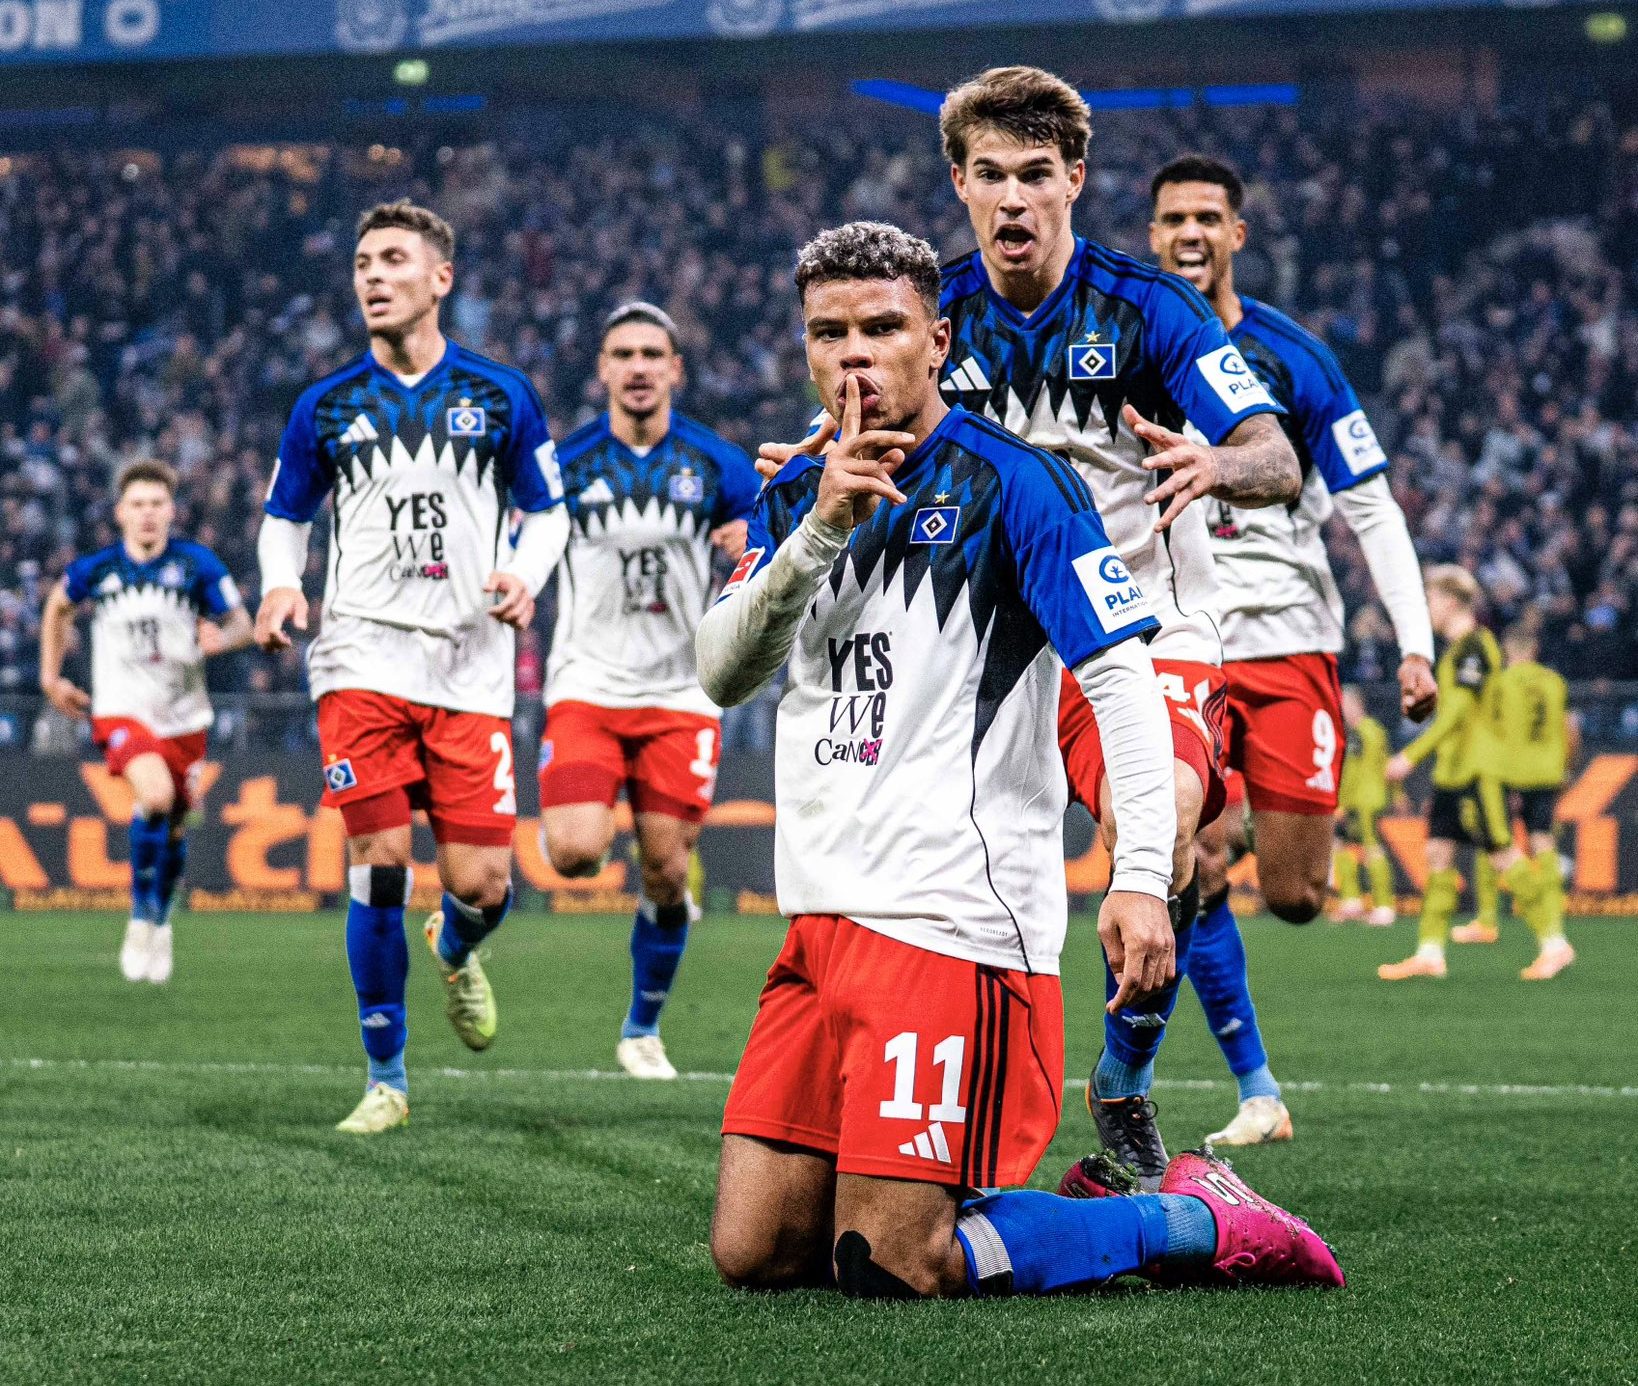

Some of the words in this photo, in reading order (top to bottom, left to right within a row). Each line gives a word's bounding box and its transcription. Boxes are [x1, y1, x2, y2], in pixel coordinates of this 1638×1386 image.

[385, 491, 447, 531] YES
[392, 532, 444, 561] We
[1104, 585, 1144, 610] PLA
[828, 631, 893, 692] YES
[830, 691, 887, 739] We
[1311, 708, 1337, 769] 9
[879, 1031, 967, 1123] 11
